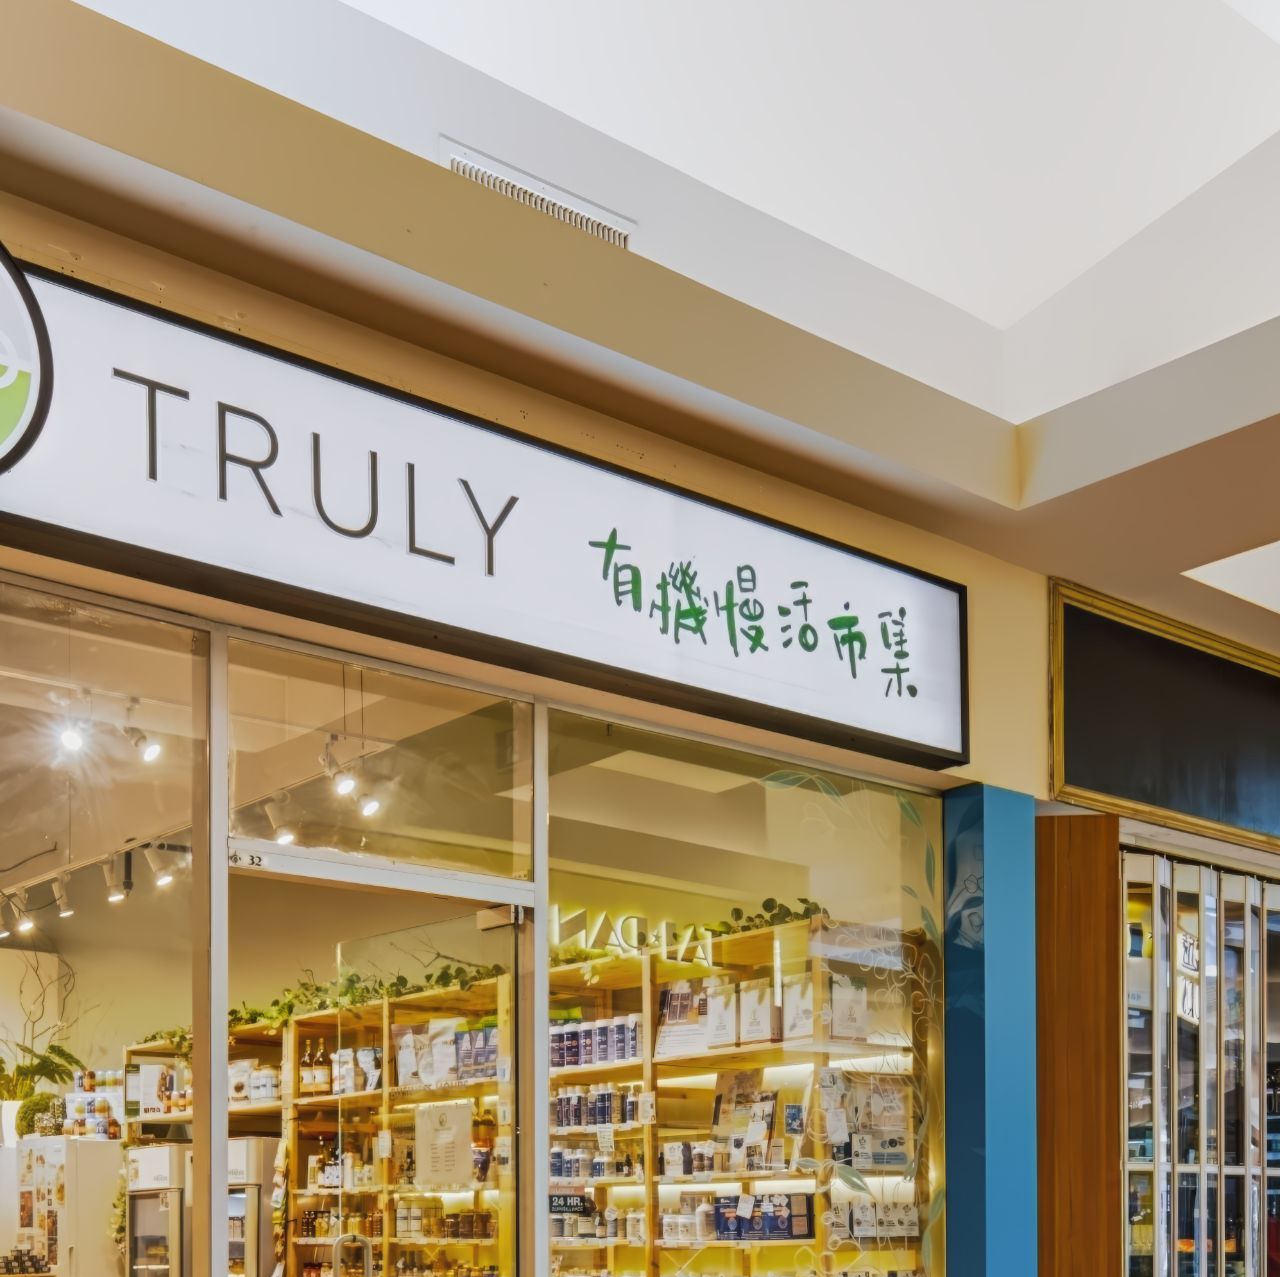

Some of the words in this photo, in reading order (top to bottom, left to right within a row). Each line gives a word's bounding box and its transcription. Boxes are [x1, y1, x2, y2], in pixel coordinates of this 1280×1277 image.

[111, 366, 520, 578] TRULY
[588, 526, 919, 699] 有機慢活市集
[247, 854, 263, 867] 32
[552, 1197, 565, 1206] 24
[566, 1197, 584, 1206] HR.
